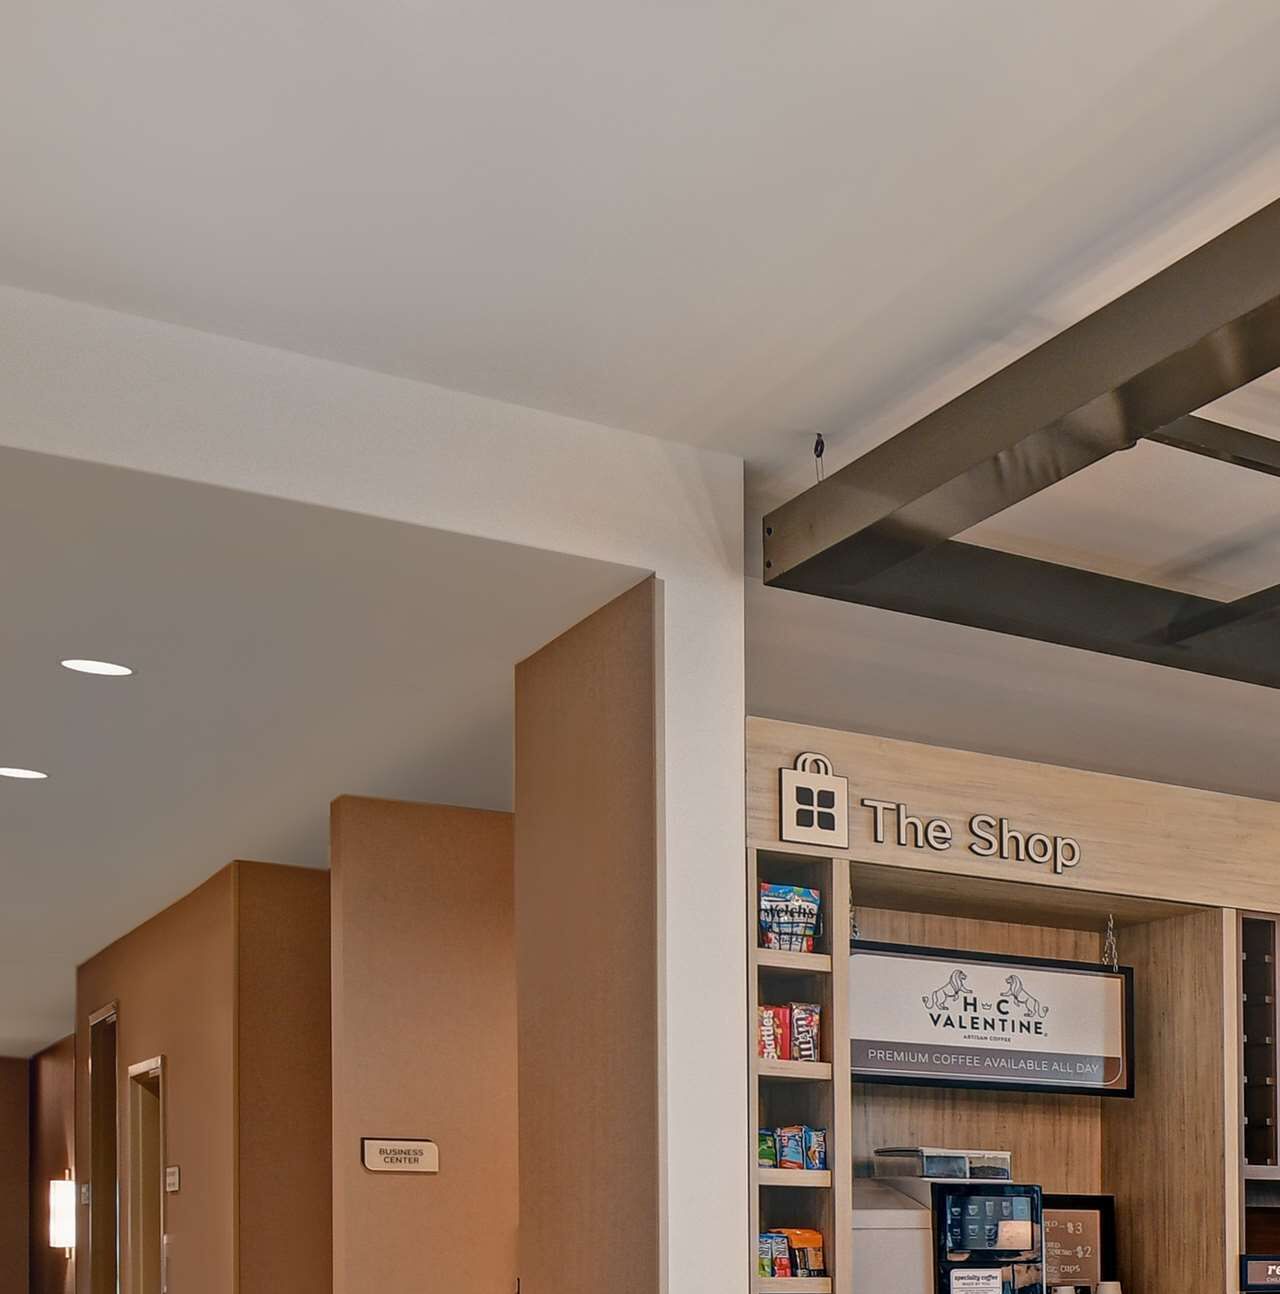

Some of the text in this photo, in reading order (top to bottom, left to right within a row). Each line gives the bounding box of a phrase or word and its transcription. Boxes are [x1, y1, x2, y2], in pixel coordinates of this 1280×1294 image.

[861, 798, 1081, 874] The Shop
[963, 996, 1010, 1015] H C
[929, 1012, 1043, 1036] VALENTINE
[868, 1049, 1099, 1074] PREMIUM COFFEE AVAILABLE ALL DAY
[378, 1147, 424, 1156] BUSINESS
[383, 1156, 419, 1164] CENTER
